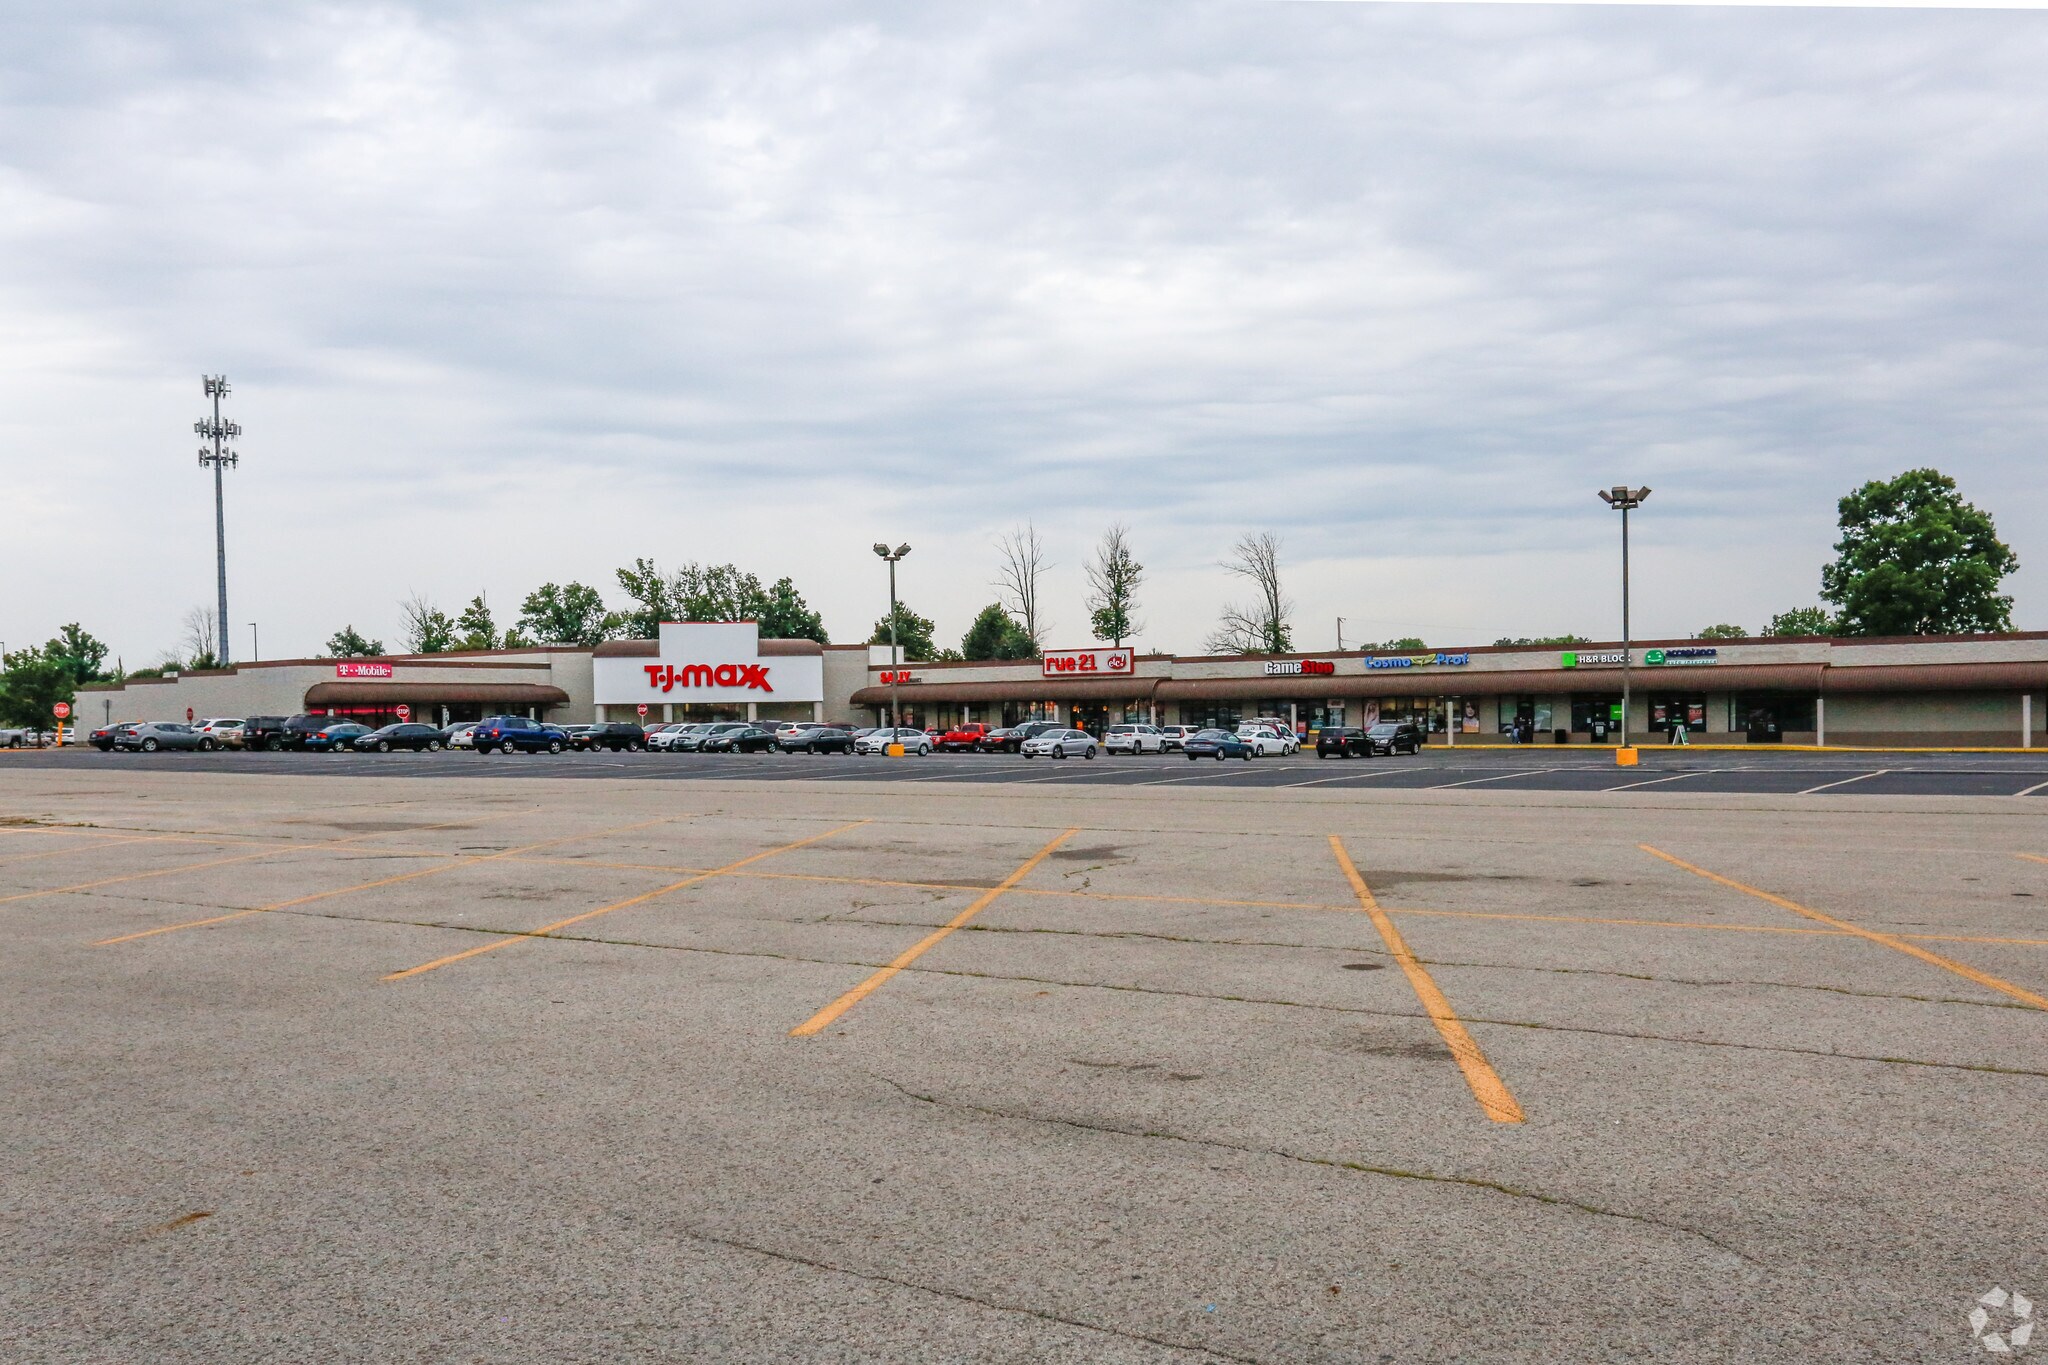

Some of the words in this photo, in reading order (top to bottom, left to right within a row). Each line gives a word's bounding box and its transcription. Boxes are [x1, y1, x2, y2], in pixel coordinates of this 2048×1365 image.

[1046, 657, 1076, 671] rue
[1078, 654, 1097, 671] 21
[1364, 655, 1412, 668] Cosmo
[1436, 652, 1470, 666] Prof
[1579, 655, 1599, 663] H&R
[1264, 659, 1335, 675] GameStop
[880, 671, 911, 684] SALY
[55, 706, 69, 714] STOP
